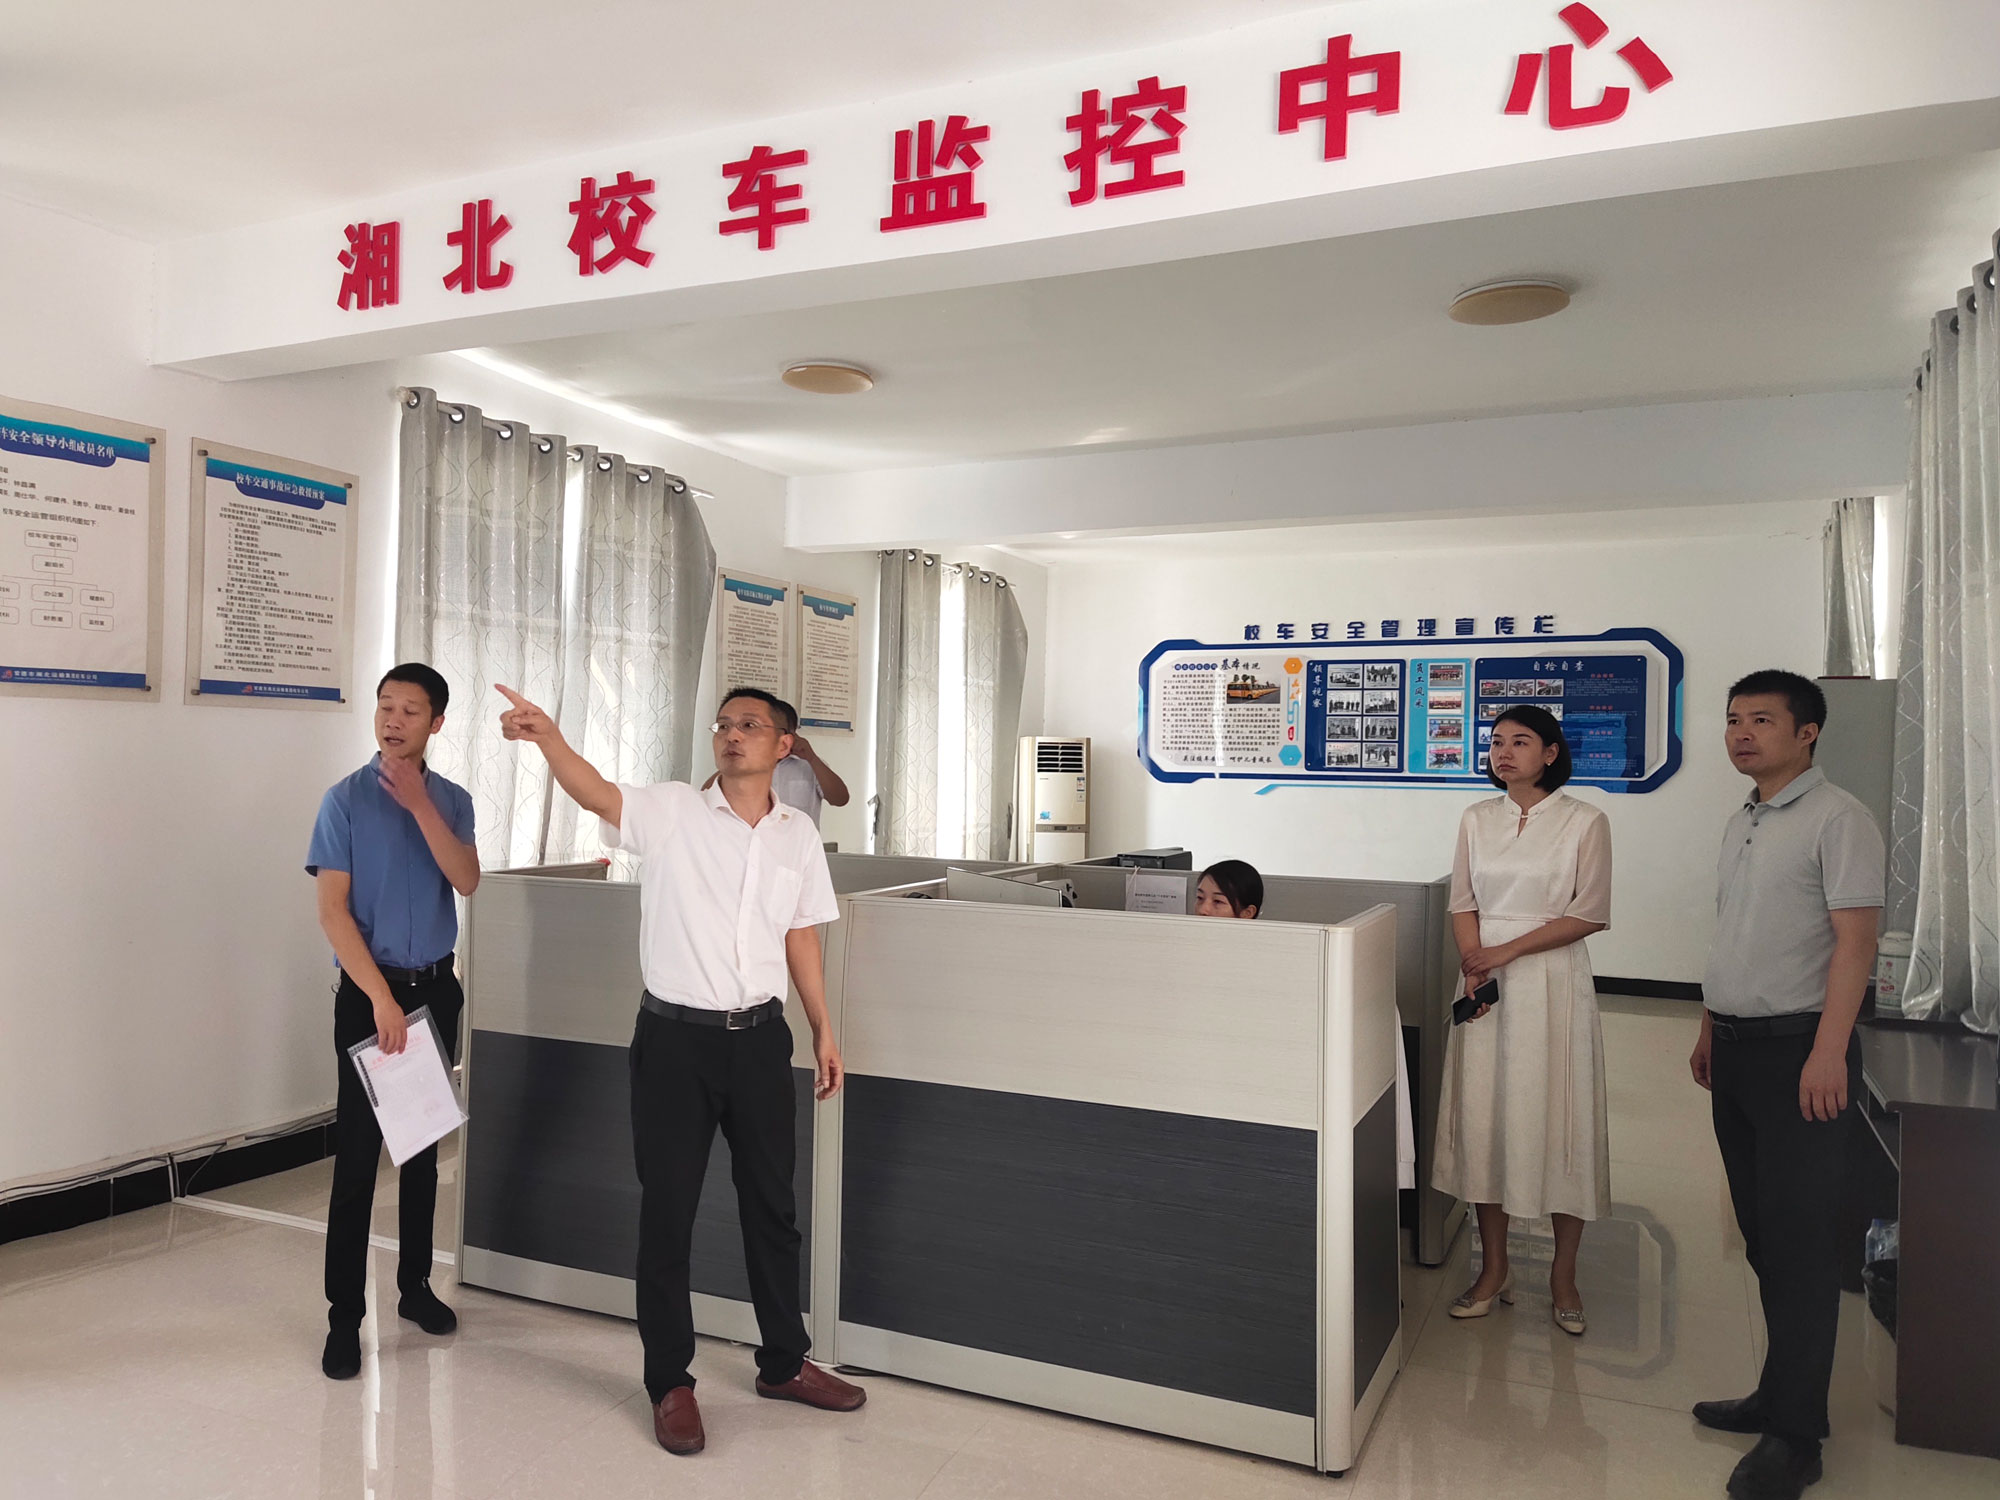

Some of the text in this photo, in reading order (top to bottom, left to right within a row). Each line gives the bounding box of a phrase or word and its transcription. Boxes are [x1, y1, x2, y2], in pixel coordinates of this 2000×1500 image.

[337, 1, 1673, 312] 湘北校车监控中心
[236, 472, 326, 501] 校车交通事故应急救援预案
[1243, 614, 1555, 641] 校车安全管理宣传栏
[1220, 658, 1261, 672] 基本情况
[1533, 660, 1585, 672] 自检自查
[1311, 664, 1323, 709] 领导视察
[1414, 662, 1426, 709] 员工风采
